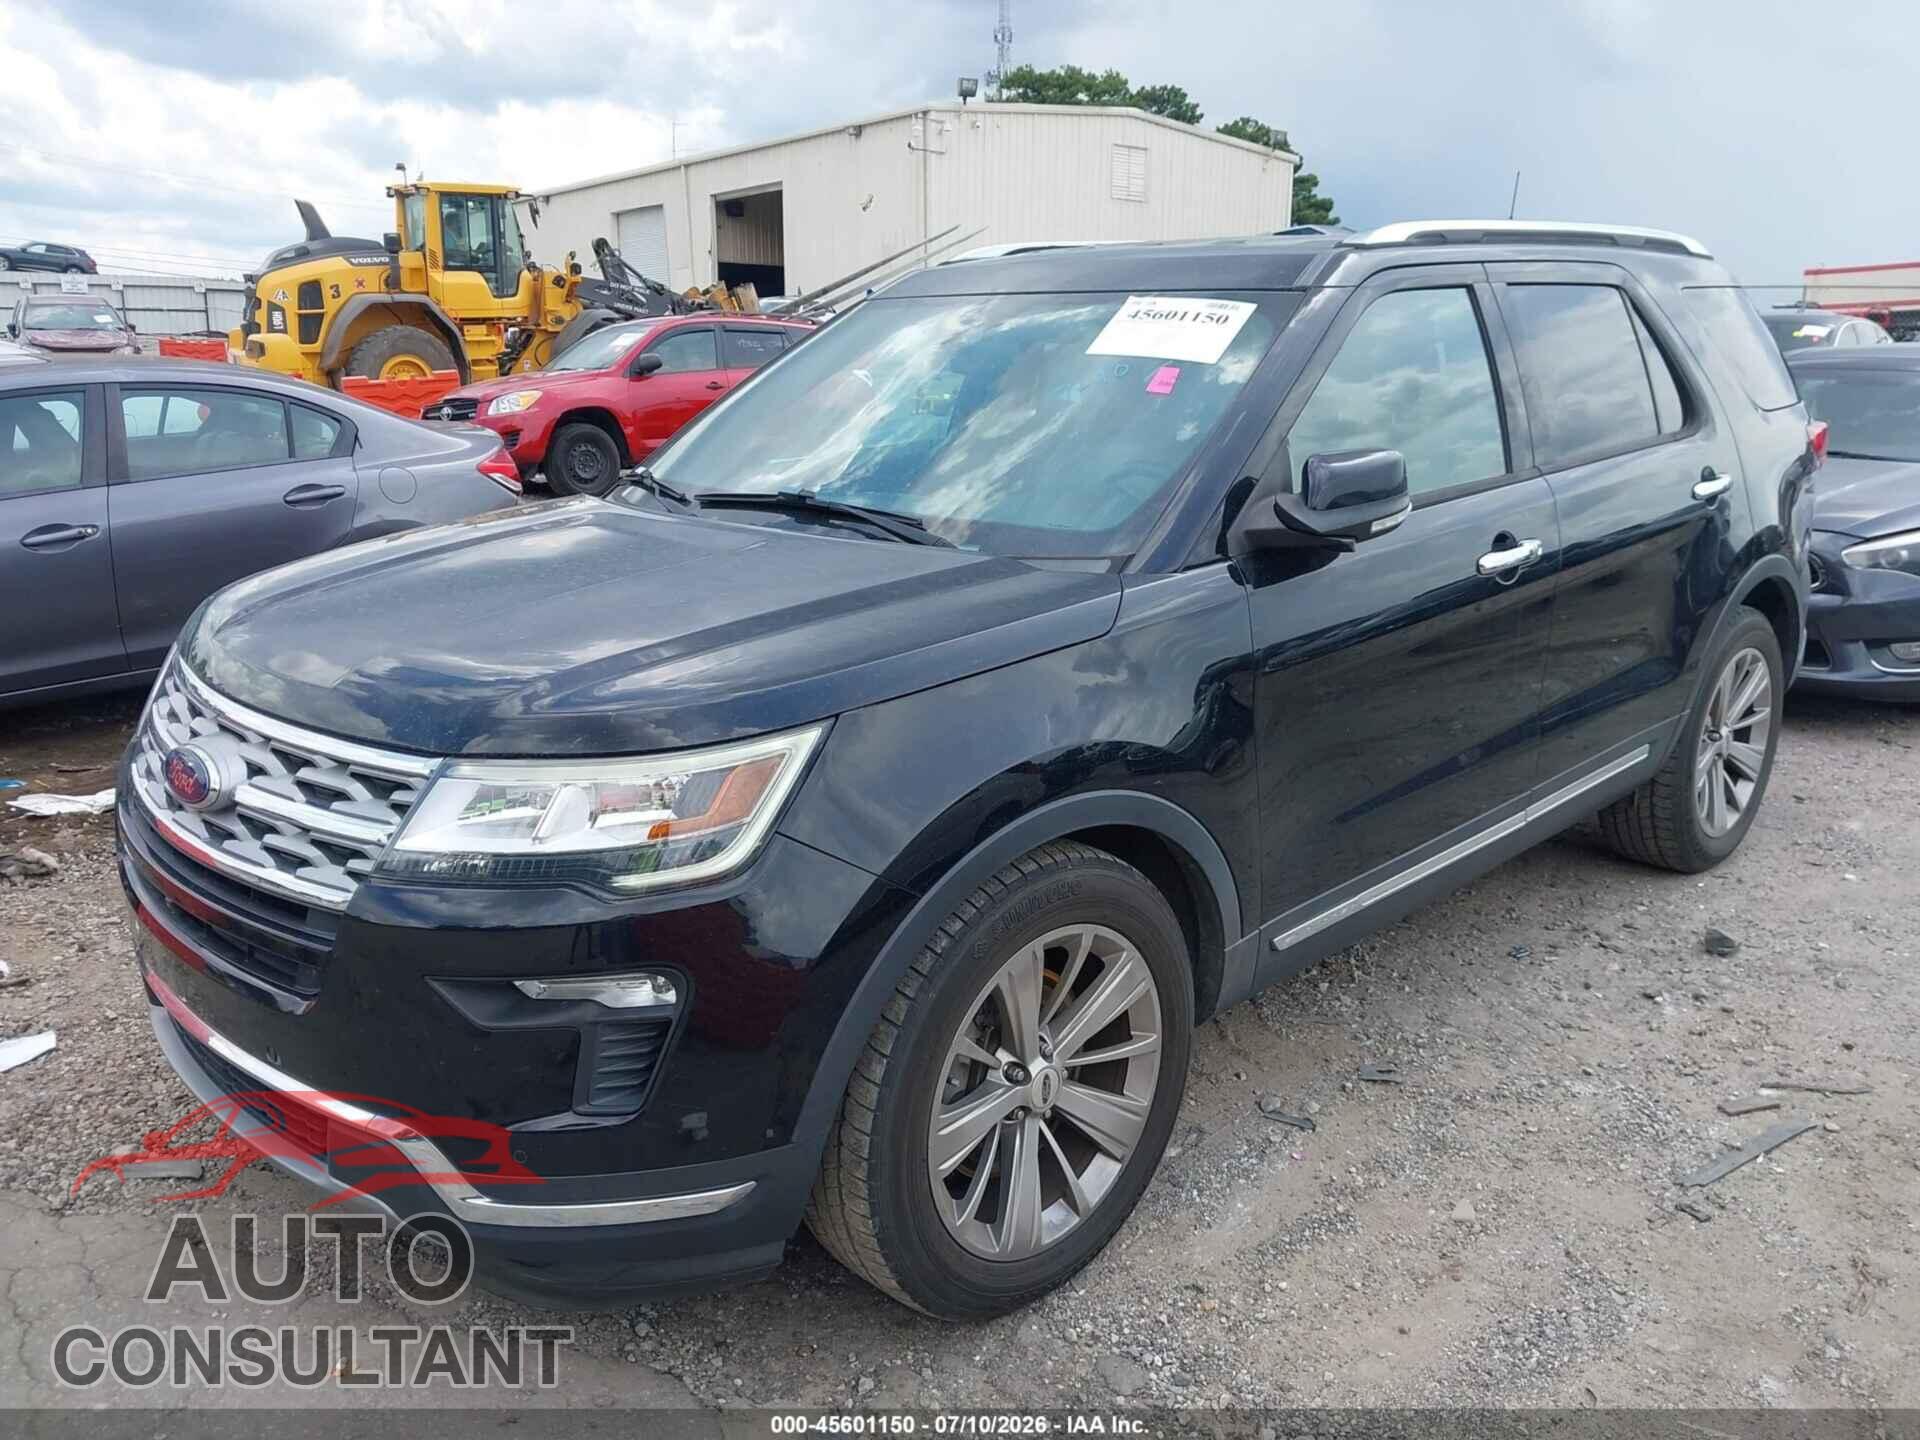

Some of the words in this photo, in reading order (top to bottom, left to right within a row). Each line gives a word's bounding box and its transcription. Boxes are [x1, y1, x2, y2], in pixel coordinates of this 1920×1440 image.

[349, 256, 389, 264] VOLVO
[329, 284, 341, 299] 3
[1128, 309, 1229, 325] 45601150
